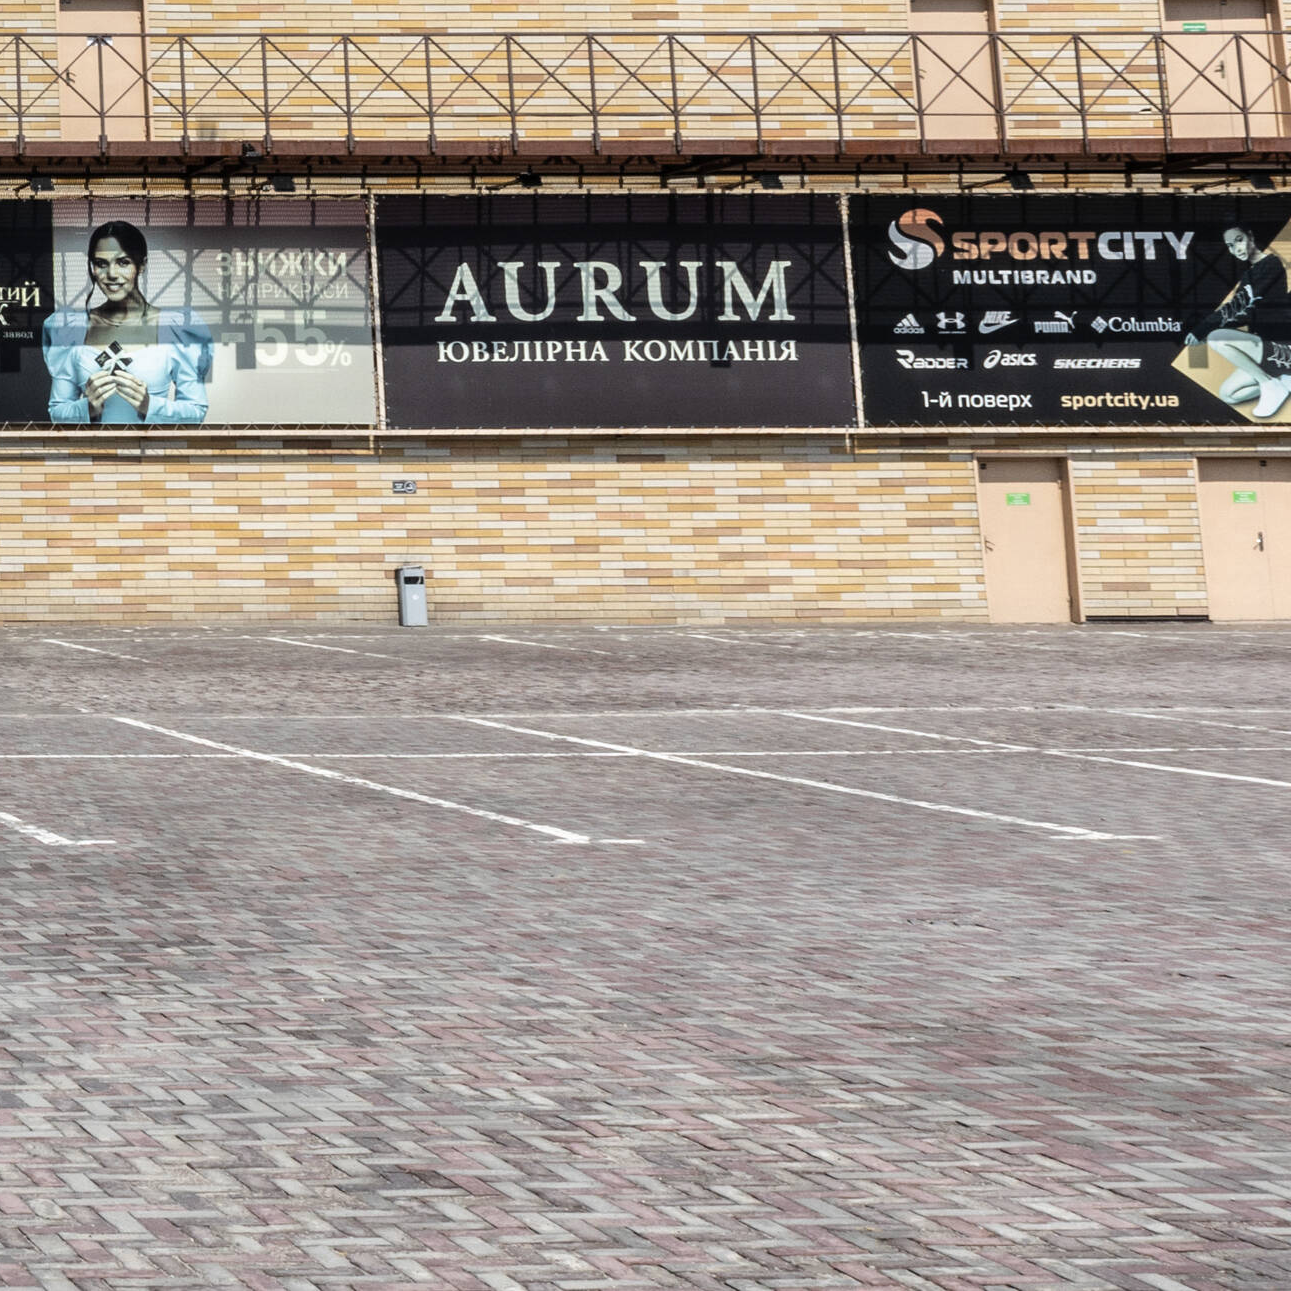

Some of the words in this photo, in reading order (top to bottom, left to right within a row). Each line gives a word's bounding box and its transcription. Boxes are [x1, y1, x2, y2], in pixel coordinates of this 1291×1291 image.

[952, 231, 1194, 261] SPORTCITY
[216, 252, 347, 277] ЗНИЖКИ
[953, 269, 1097, 285] MULTIBRAND
[434, 260, 795, 322] AURUM
[985, 311, 1012, 322] NIKE
[1108, 317, 1181, 332] Columbia
[3, 331, 34, 340] завод
[1034, 321, 1069, 333] PUMA
[437, 340, 609, 363] ЮВЕЛІРНА
[623, 339, 799, 361] КОМПАНІЯ
[1053, 358, 1142, 370] SKECHERS
[922, 391, 952, 408] 1-й
[958, 392, 1033, 412] поверх
[1060, 392, 1179, 411] sportcity.ua
